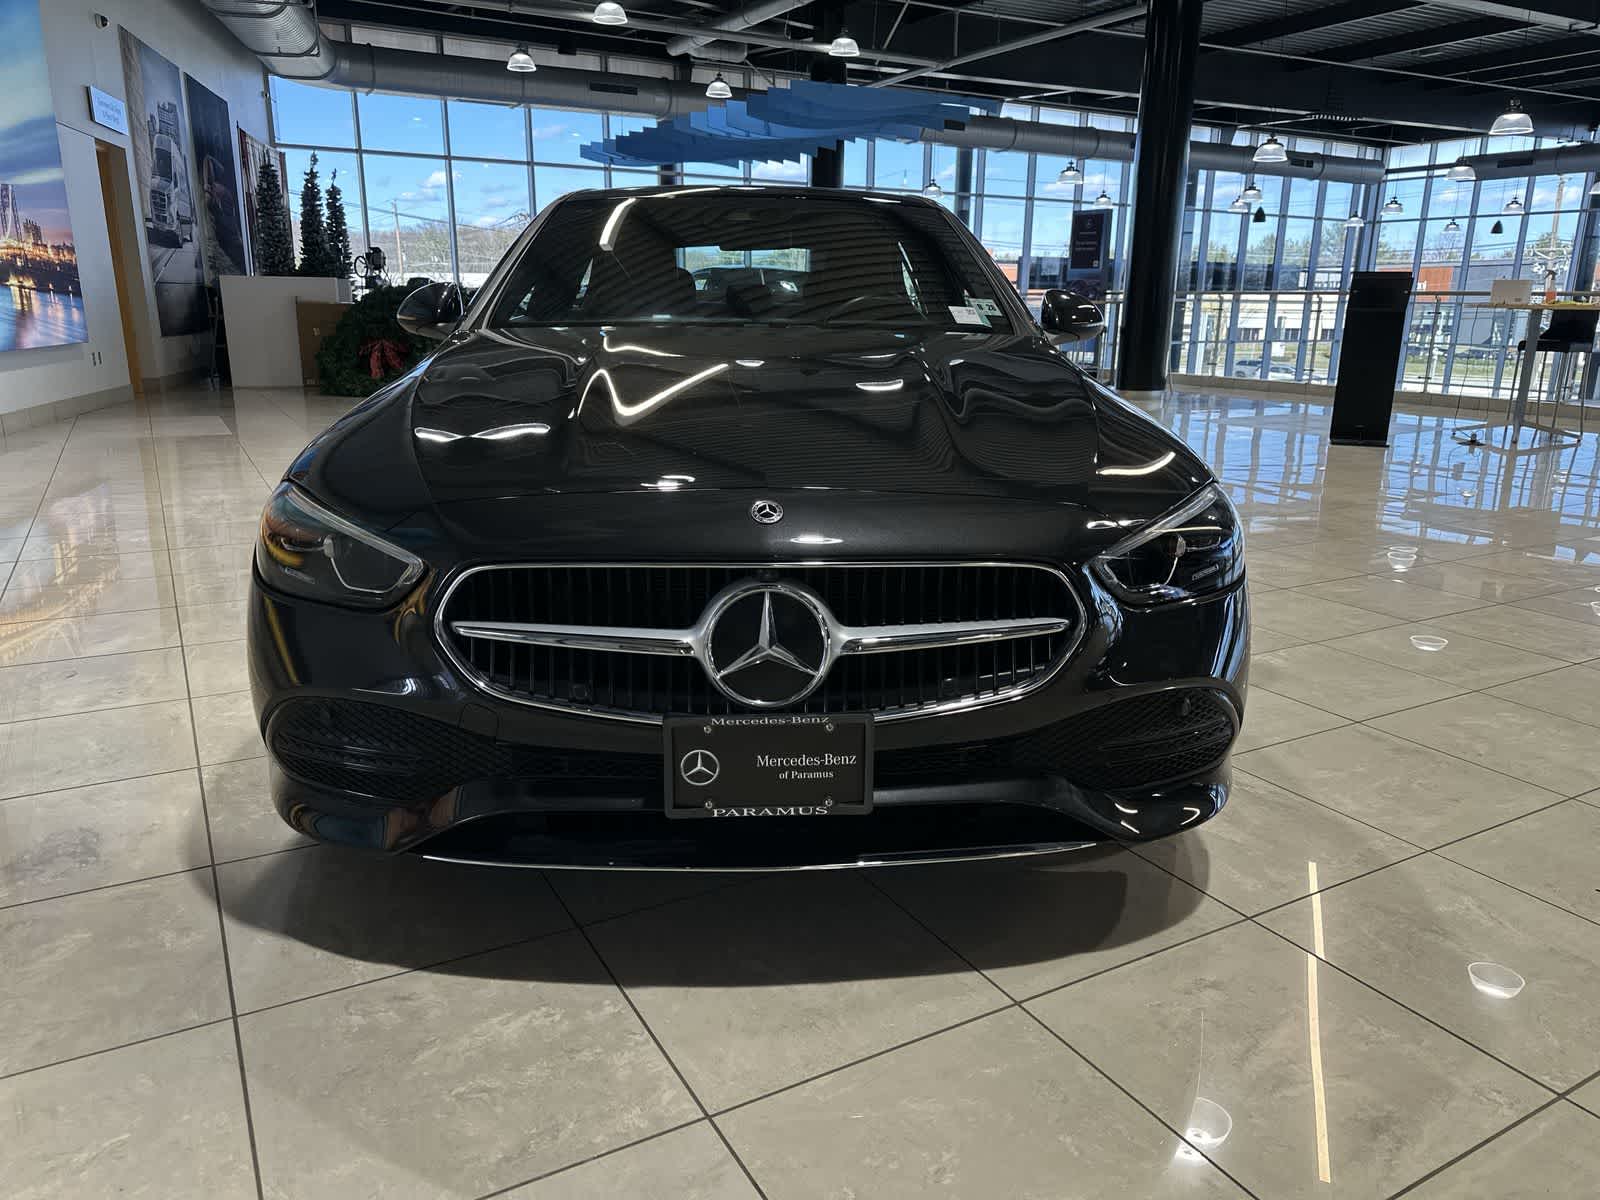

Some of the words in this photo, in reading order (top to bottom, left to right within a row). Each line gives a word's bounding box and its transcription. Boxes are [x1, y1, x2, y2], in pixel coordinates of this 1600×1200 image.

[711, 716, 830, 726] Mercedes-Benz
[756, 753, 857, 767] Mercedes-Benz
[778, 771, 788, 779] of
[791, 770, 834, 779] Paramus
[712, 806, 828, 817] PARAMUS
